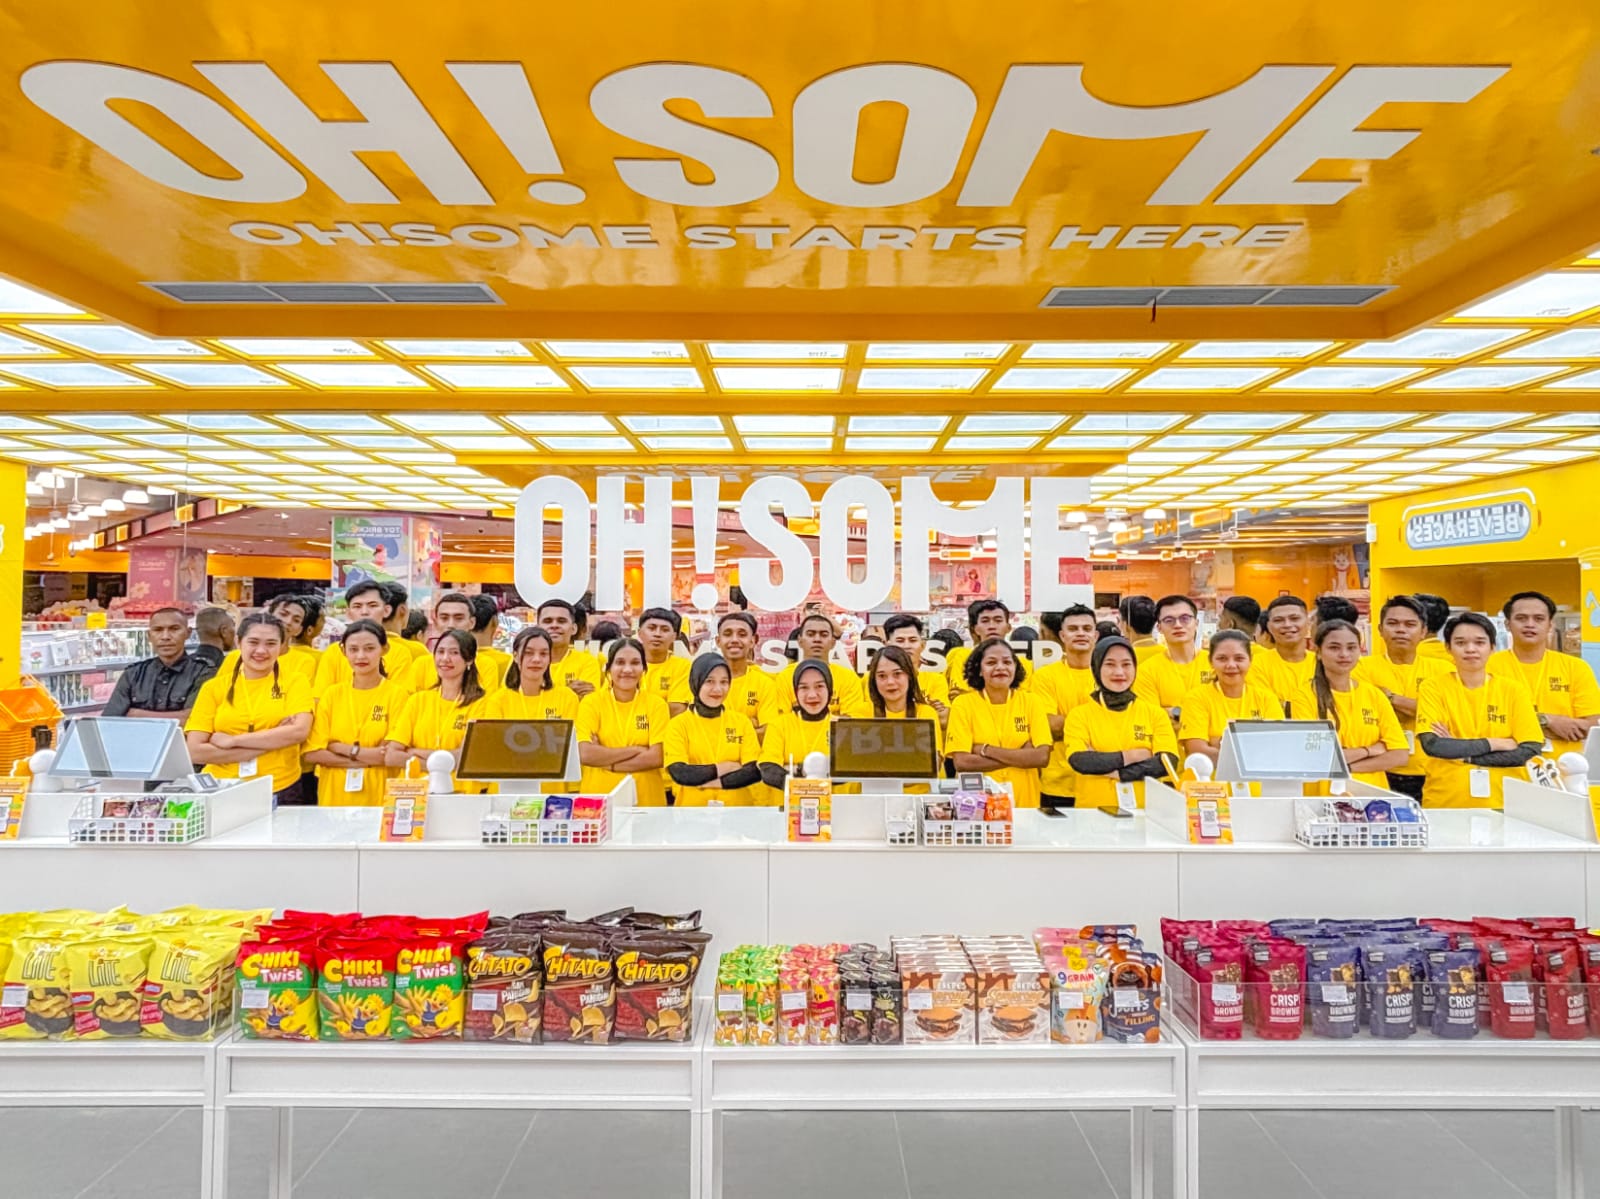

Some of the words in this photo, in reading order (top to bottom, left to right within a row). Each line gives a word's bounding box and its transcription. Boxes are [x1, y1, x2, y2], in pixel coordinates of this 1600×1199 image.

[20, 60, 1512, 208] OH!SOME
[229, 221, 656, 249] OH!SOME
[684, 223, 1027, 251] STARTS
[1049, 223, 1304, 251] HERE
[514, 475, 1094, 612] OH!SOME
[241, 951, 300, 978] CHIKI
[323, 959, 383, 983] CHIKI
[397, 946, 452, 974] CHIKI
[413, 963, 457, 979] Twist
[260, 968, 304, 983] Twist
[344, 976, 389, 988] Twist
[1058, 971, 1067, 985] 9
[1270, 994, 1300, 1006] CRISP
